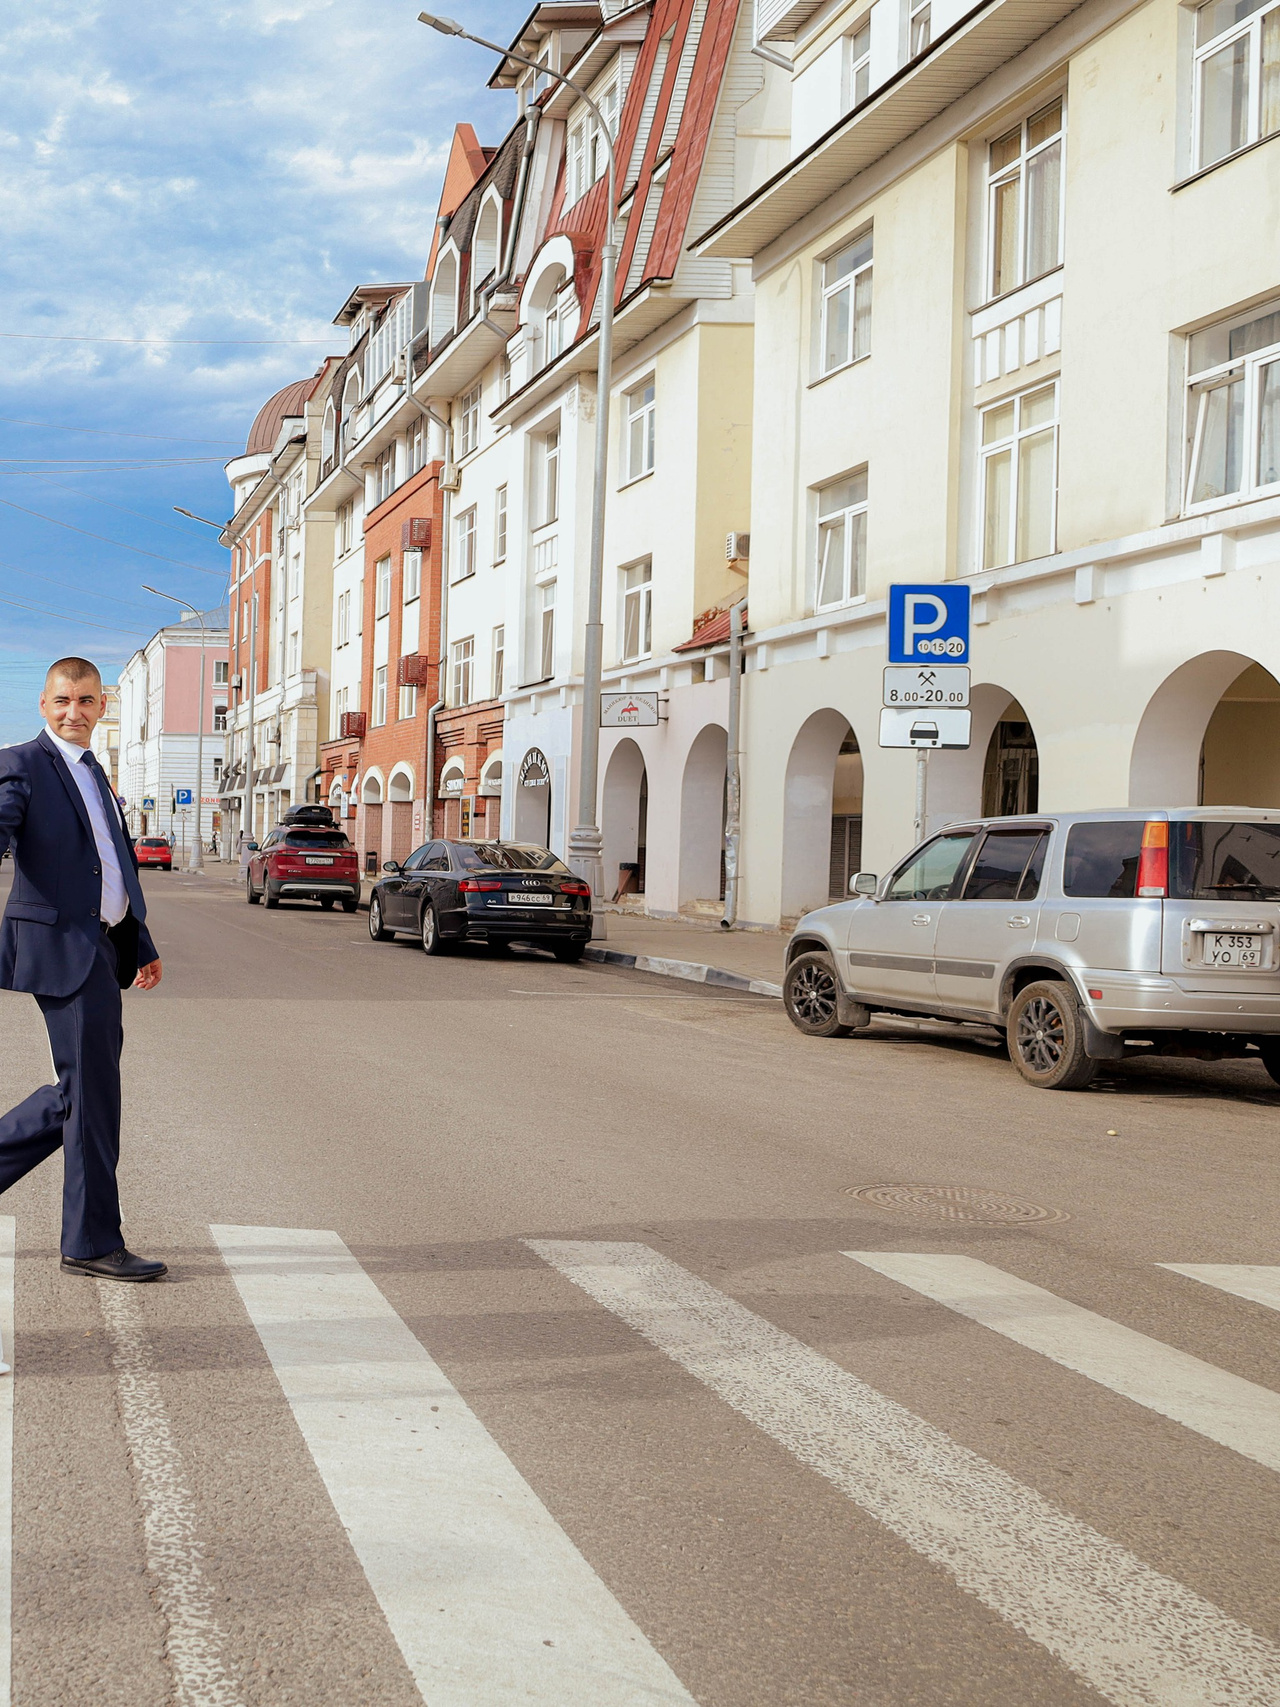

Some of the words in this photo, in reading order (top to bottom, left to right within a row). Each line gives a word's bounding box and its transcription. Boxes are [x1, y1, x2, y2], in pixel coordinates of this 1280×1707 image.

[903, 593, 948, 655] P
[932, 643, 944, 651] 15
[948, 643, 963, 653] 20
[179, 791, 188, 803] P
[1242, 952, 1255, 961] 69
